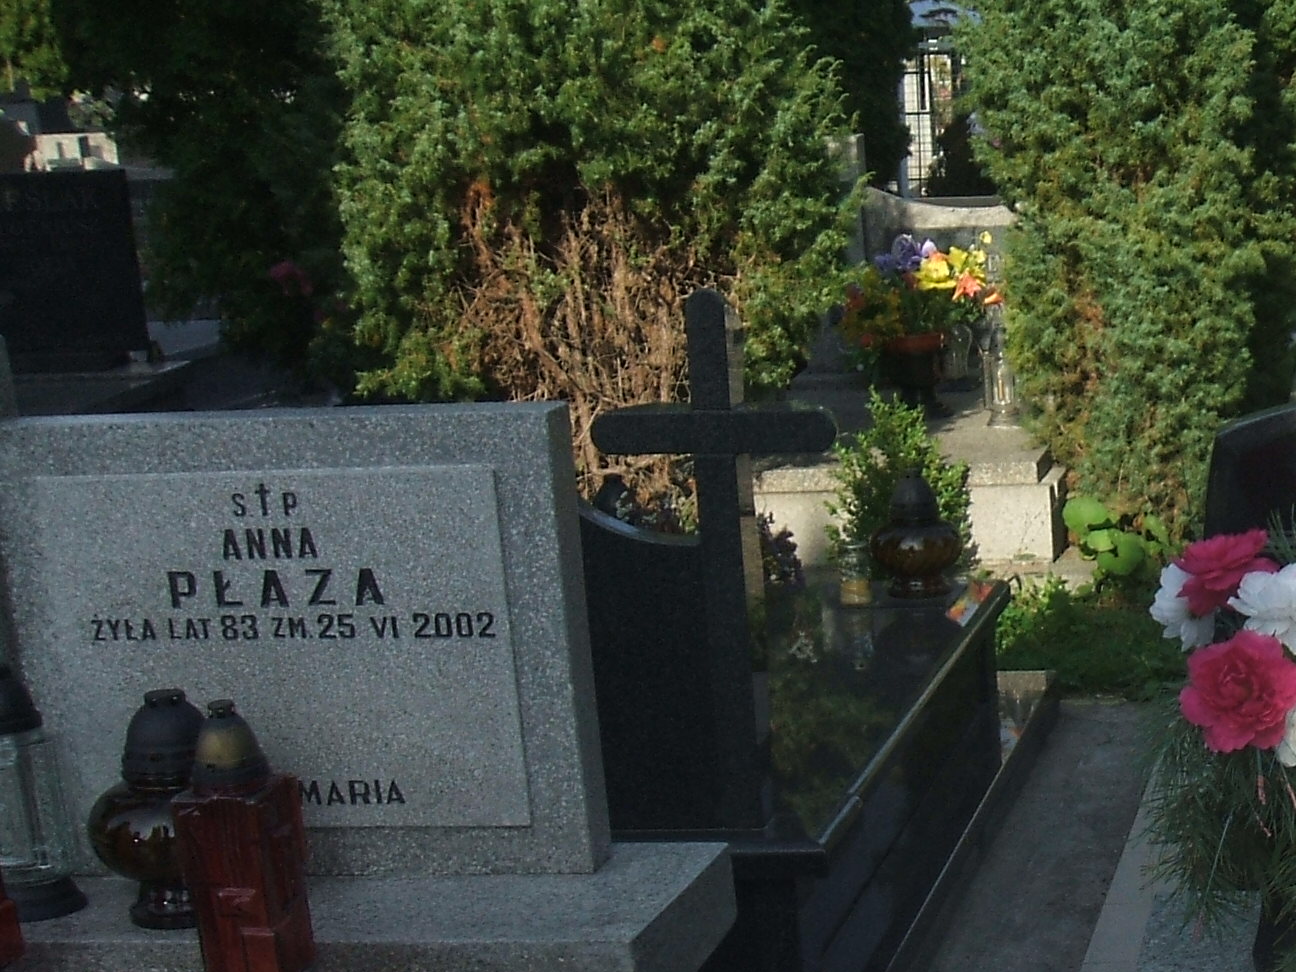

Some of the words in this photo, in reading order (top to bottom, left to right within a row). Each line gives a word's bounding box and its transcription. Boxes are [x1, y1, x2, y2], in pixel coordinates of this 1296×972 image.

[223, 527, 318, 561] ANNA
[167, 567, 386, 609] PŁAZA
[91, 614, 156, 641] ŻYŁA
[168, 617, 211, 641] LAT
[220, 614, 260, 641] 83
[317, 613, 356, 639] 25
[369, 616, 400, 639] VI
[413, 612, 497, 639] 2002
[297, 778, 407, 806] MARIA
